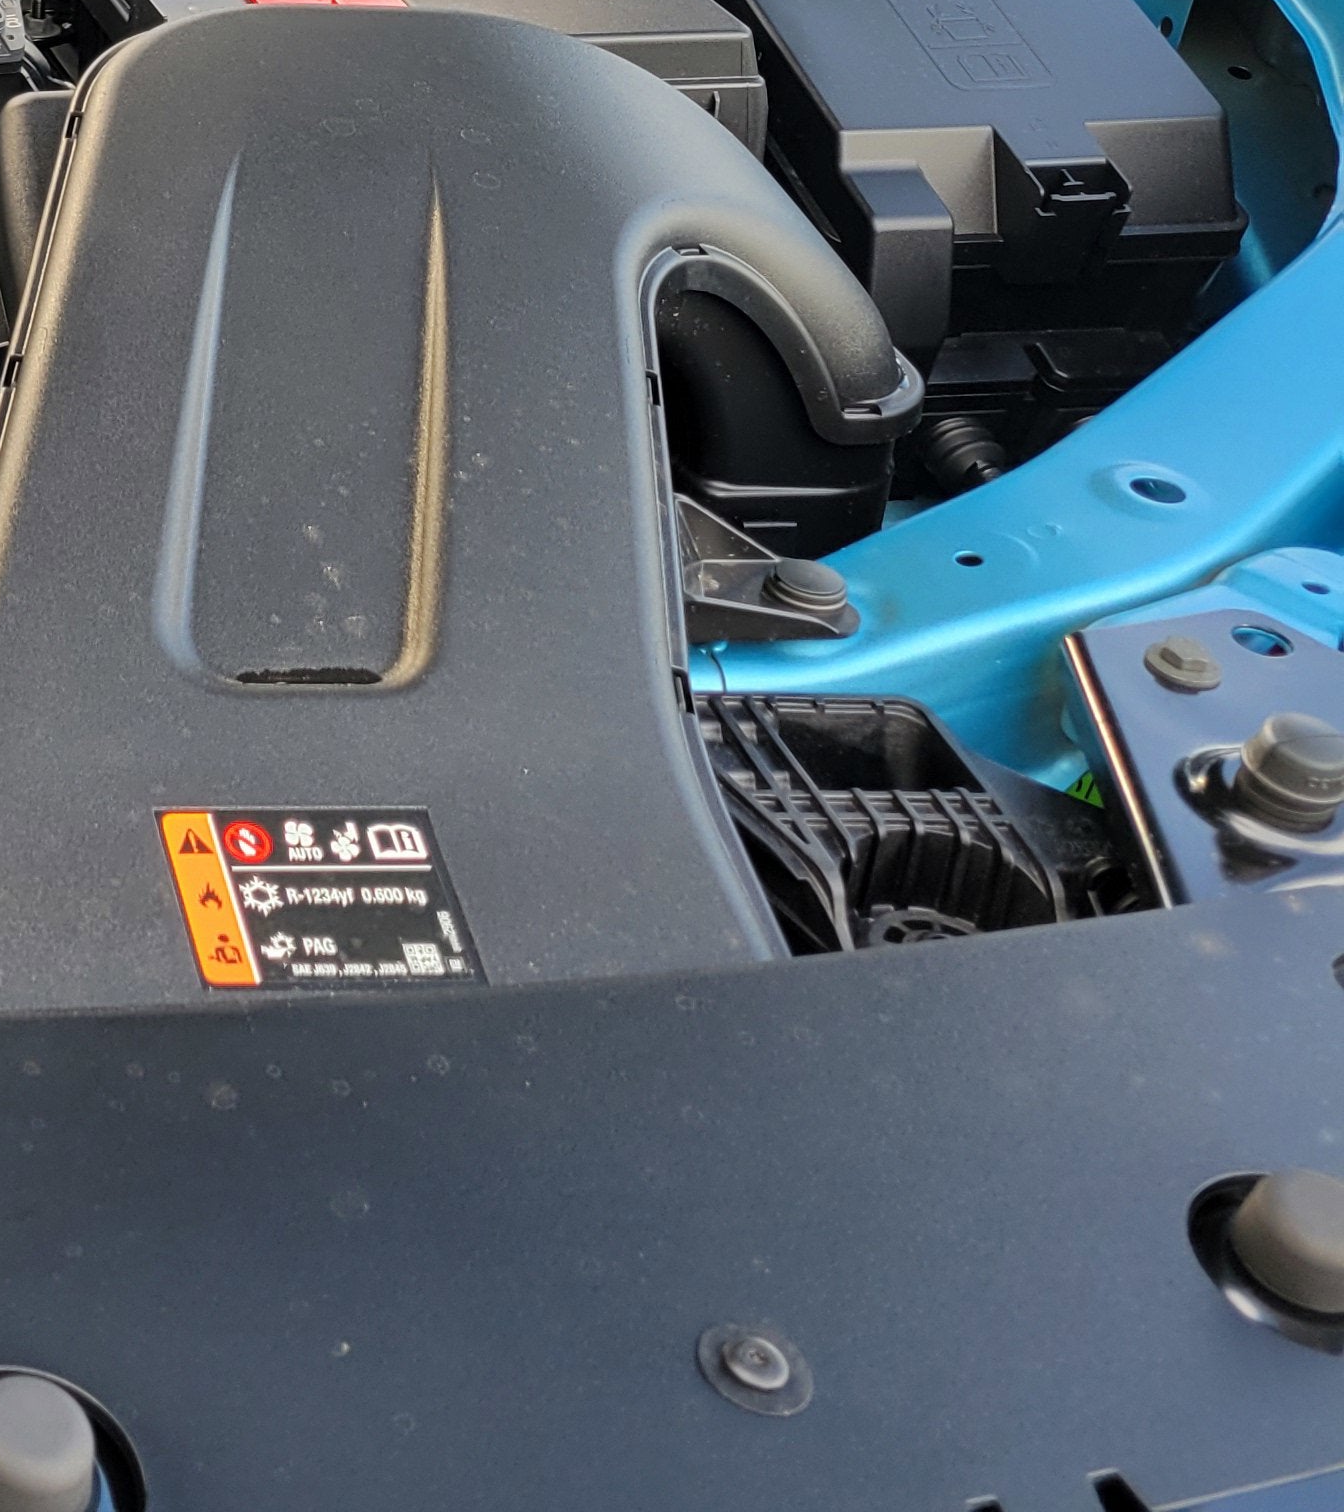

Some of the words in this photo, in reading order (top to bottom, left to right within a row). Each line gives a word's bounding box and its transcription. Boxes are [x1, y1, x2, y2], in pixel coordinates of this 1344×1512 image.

[288, 846, 323, 862] AUTO
[285, 886, 354, 908] R-1234yf
[360, 887, 404, 905] 0.600
[404, 885, 428, 907] kg
[302, 937, 338, 956] PAG
